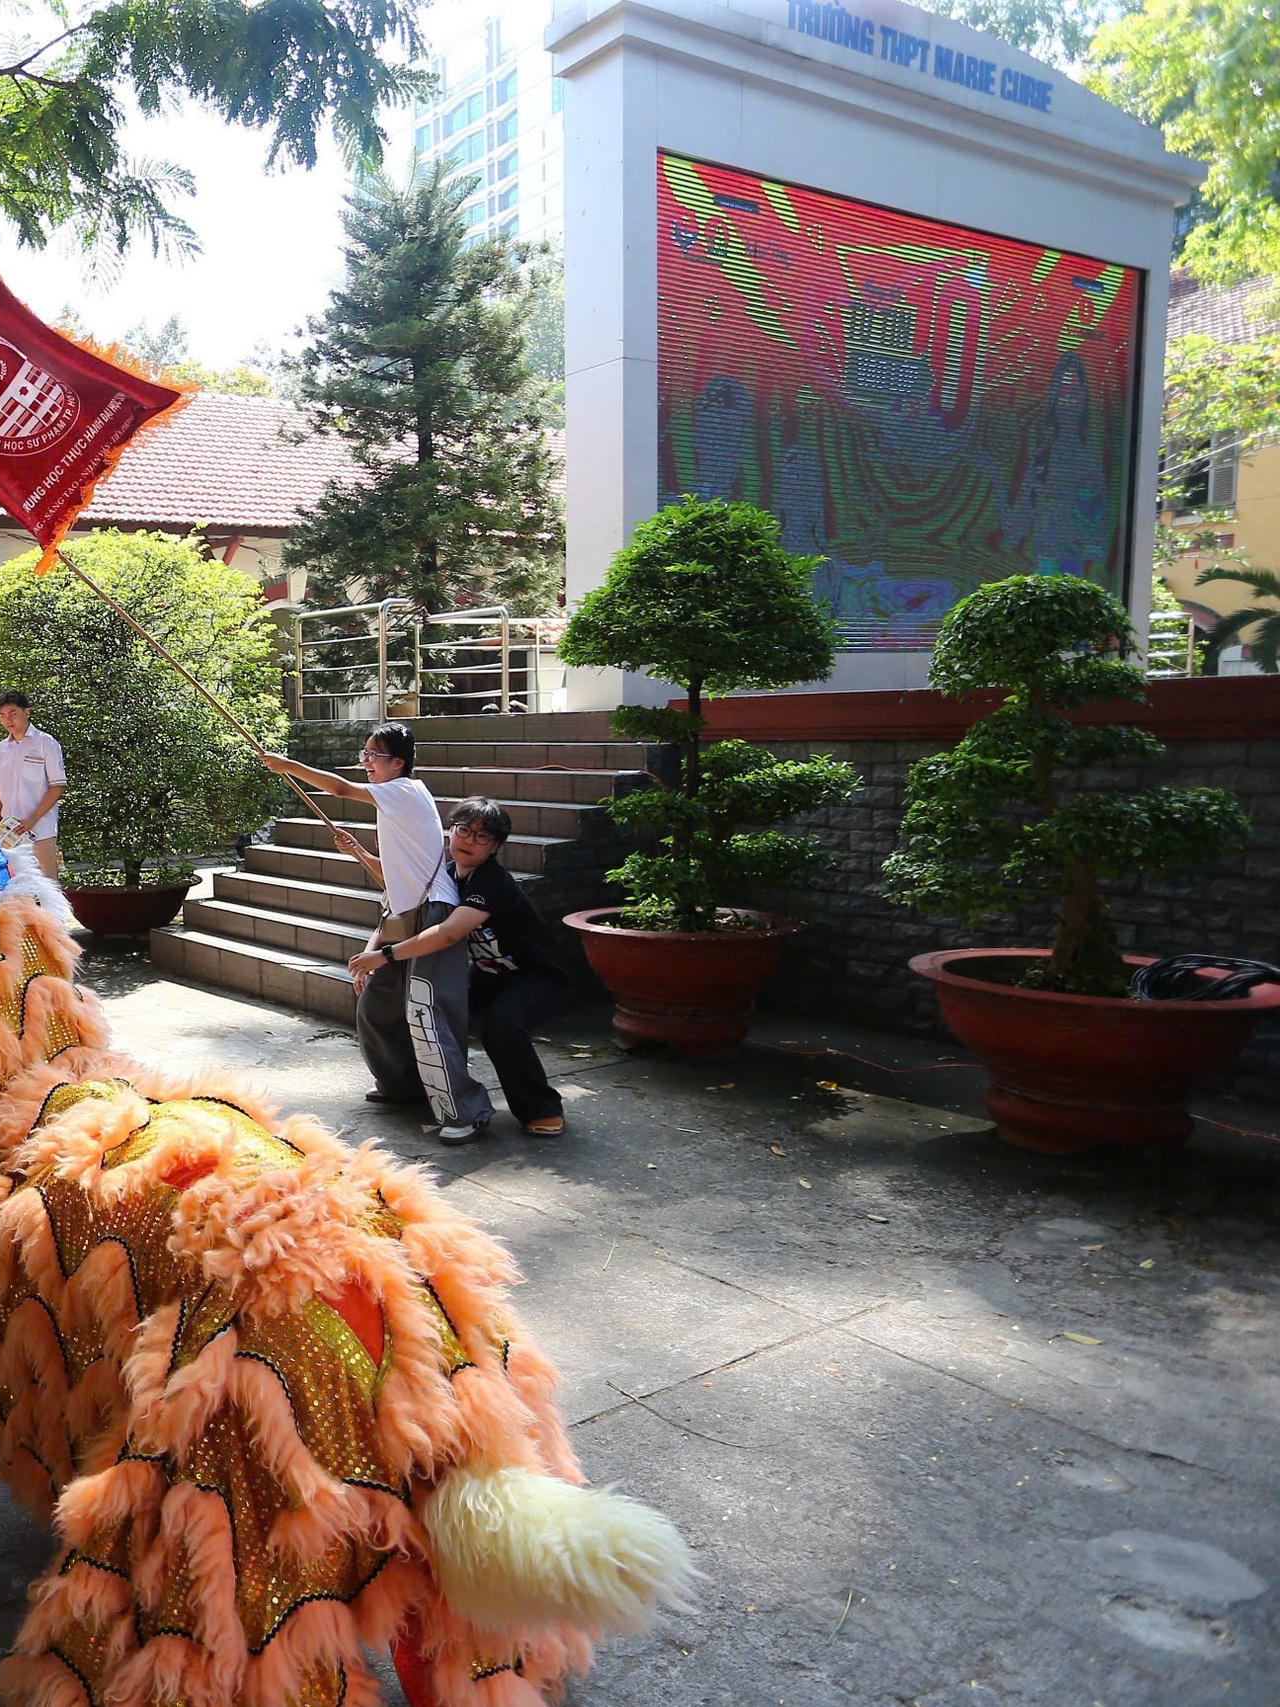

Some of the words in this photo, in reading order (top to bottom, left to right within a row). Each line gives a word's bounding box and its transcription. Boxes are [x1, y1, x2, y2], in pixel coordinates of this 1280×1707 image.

[880, 24, 930, 75] THPT
[933, 44, 997, 96] MARIE
[1000, 67, 1053, 114] CURIE
[3, 441, 24, 452] HỌC
[27, 437, 40, 448] SƯ
[41, 419, 67, 443] PHẠM
[22, 486, 46, 513] RUNG
[42, 465, 65, 489] HỌC
[60, 438, 87, 467] THỰC
[83, 416, 105, 442] HÀNH
